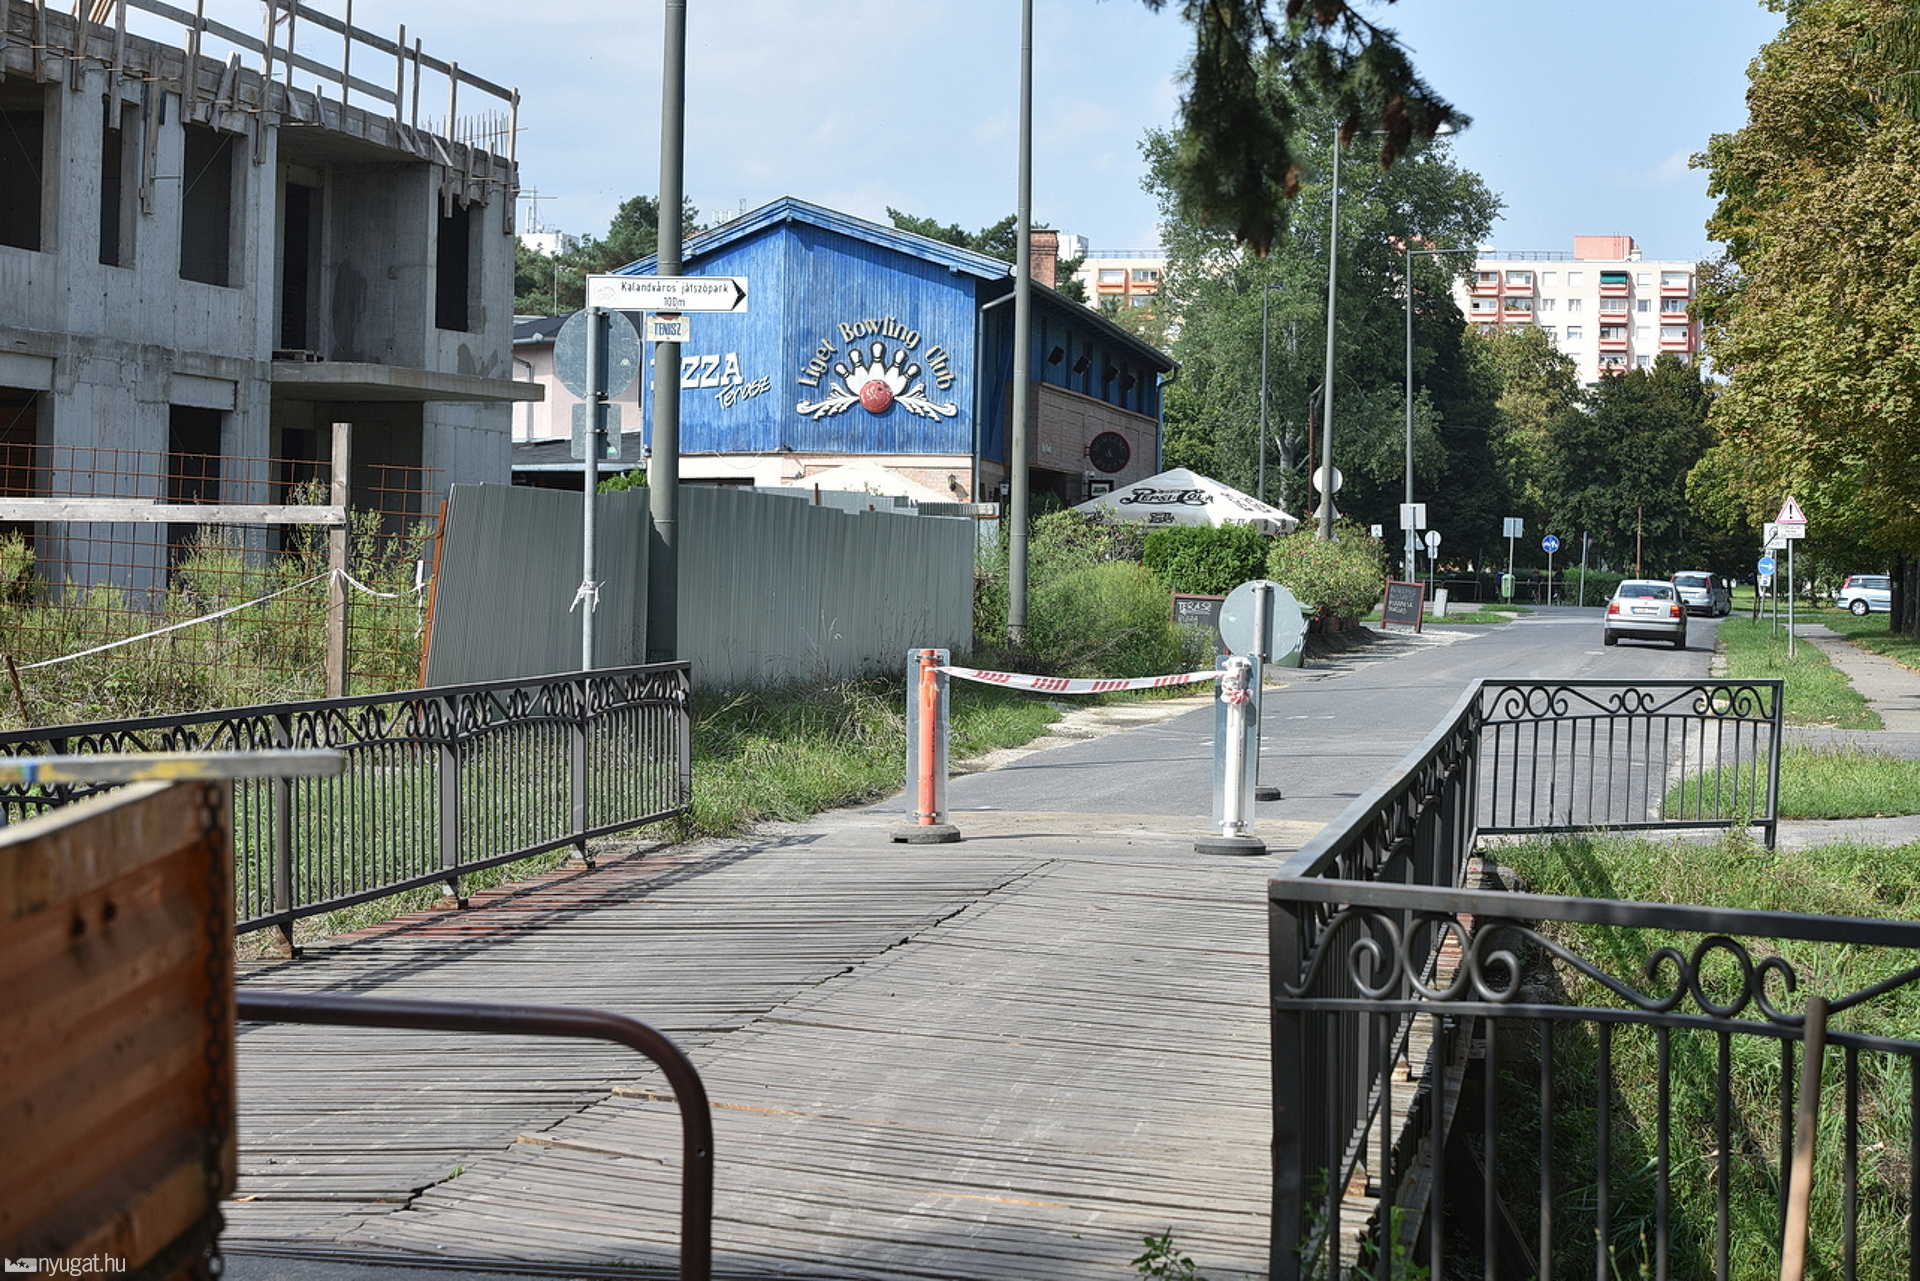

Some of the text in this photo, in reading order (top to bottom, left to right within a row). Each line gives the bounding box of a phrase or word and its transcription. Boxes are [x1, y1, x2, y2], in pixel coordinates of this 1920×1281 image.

[681, 281, 729, 296] játszópark
[650, 352, 744, 391] ZZA
[836, 315, 922, 350] Bowling
[924, 345, 957, 391] Club
